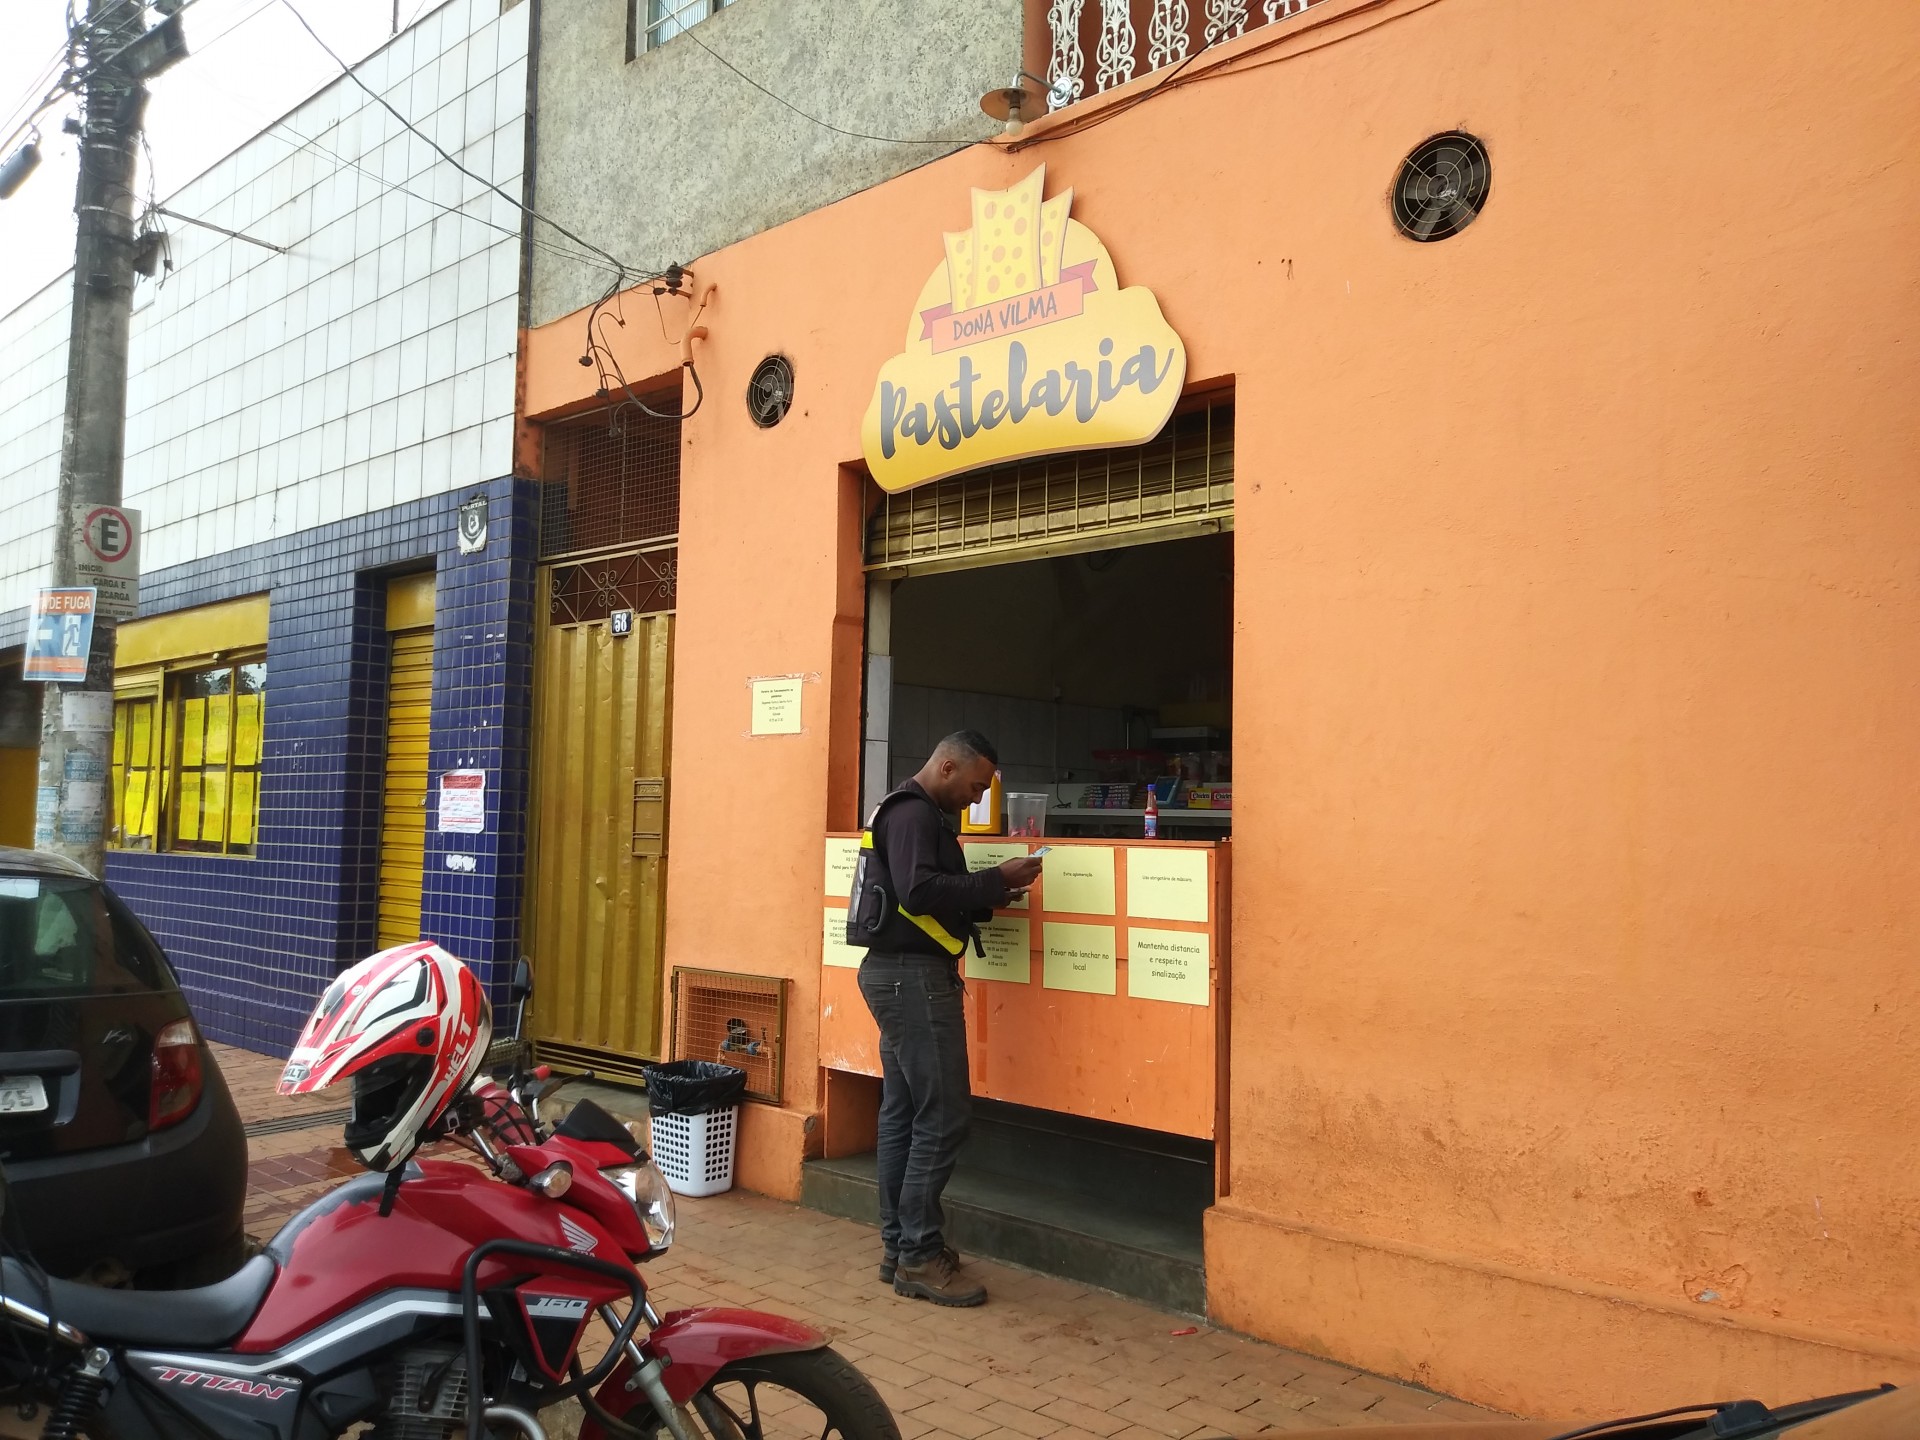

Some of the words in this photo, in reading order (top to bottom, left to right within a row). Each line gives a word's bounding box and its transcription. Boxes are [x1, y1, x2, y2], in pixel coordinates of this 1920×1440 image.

[953, 309, 995, 341] DONA
[999, 291, 1057, 329] VILMA
[880, 337, 1176, 460] Pastelaria
[461, 500, 488, 512] PORTAL
[101, 517, 120, 552] E
[92, 578, 119, 589] CARGA
[49, 596, 61, 610] DE
[64, 595, 91, 610] FUGA
[614, 612, 628, 633] 58
[1050, 947, 1066, 957] Favor
[1067, 949, 1078, 958] não
[1079, 950, 1102, 960] lanchar
[1137, 941, 1169, 952] Mantenha
[1072, 962, 1087, 971] local
[1154, 957, 1182, 967] respeite
[1151, 970, 1186, 981] sinalização
[444, 1012, 472, 1083] HELT
[151, 1366, 297, 1401] TITAN
